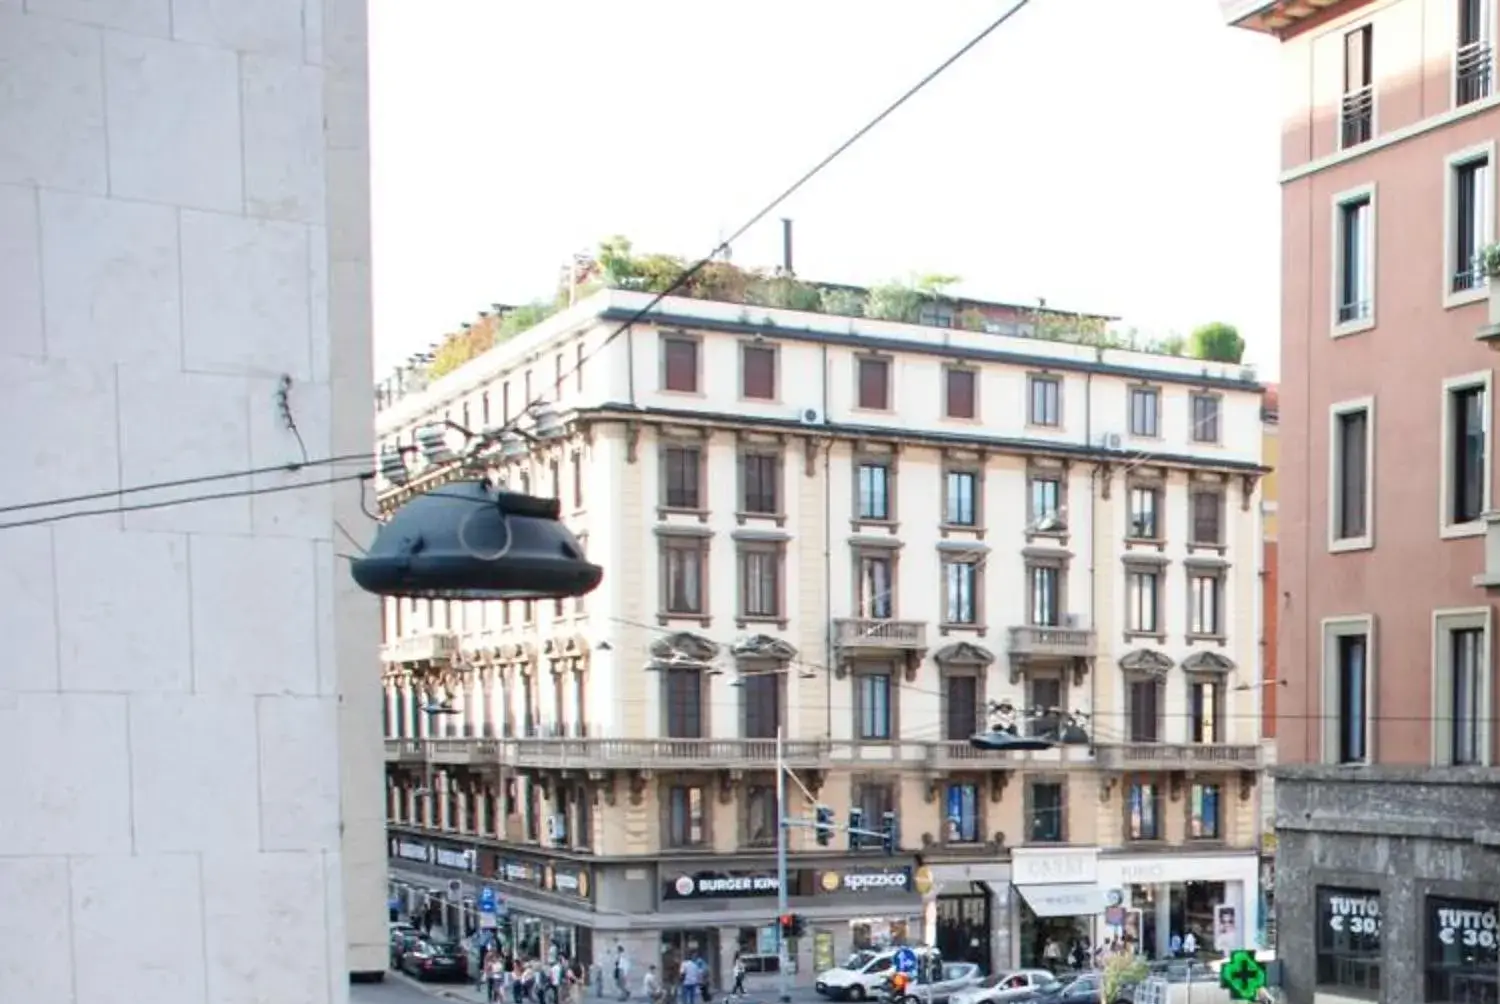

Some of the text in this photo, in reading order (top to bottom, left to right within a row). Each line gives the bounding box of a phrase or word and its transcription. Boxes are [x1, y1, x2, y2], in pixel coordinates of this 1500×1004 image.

[698, 878, 751, 893] BURGER
[843, 873, 907, 891] spizzico
[1329, 897, 1379, 917] TUTTO
[1438, 908, 1496, 929] TUTTO
